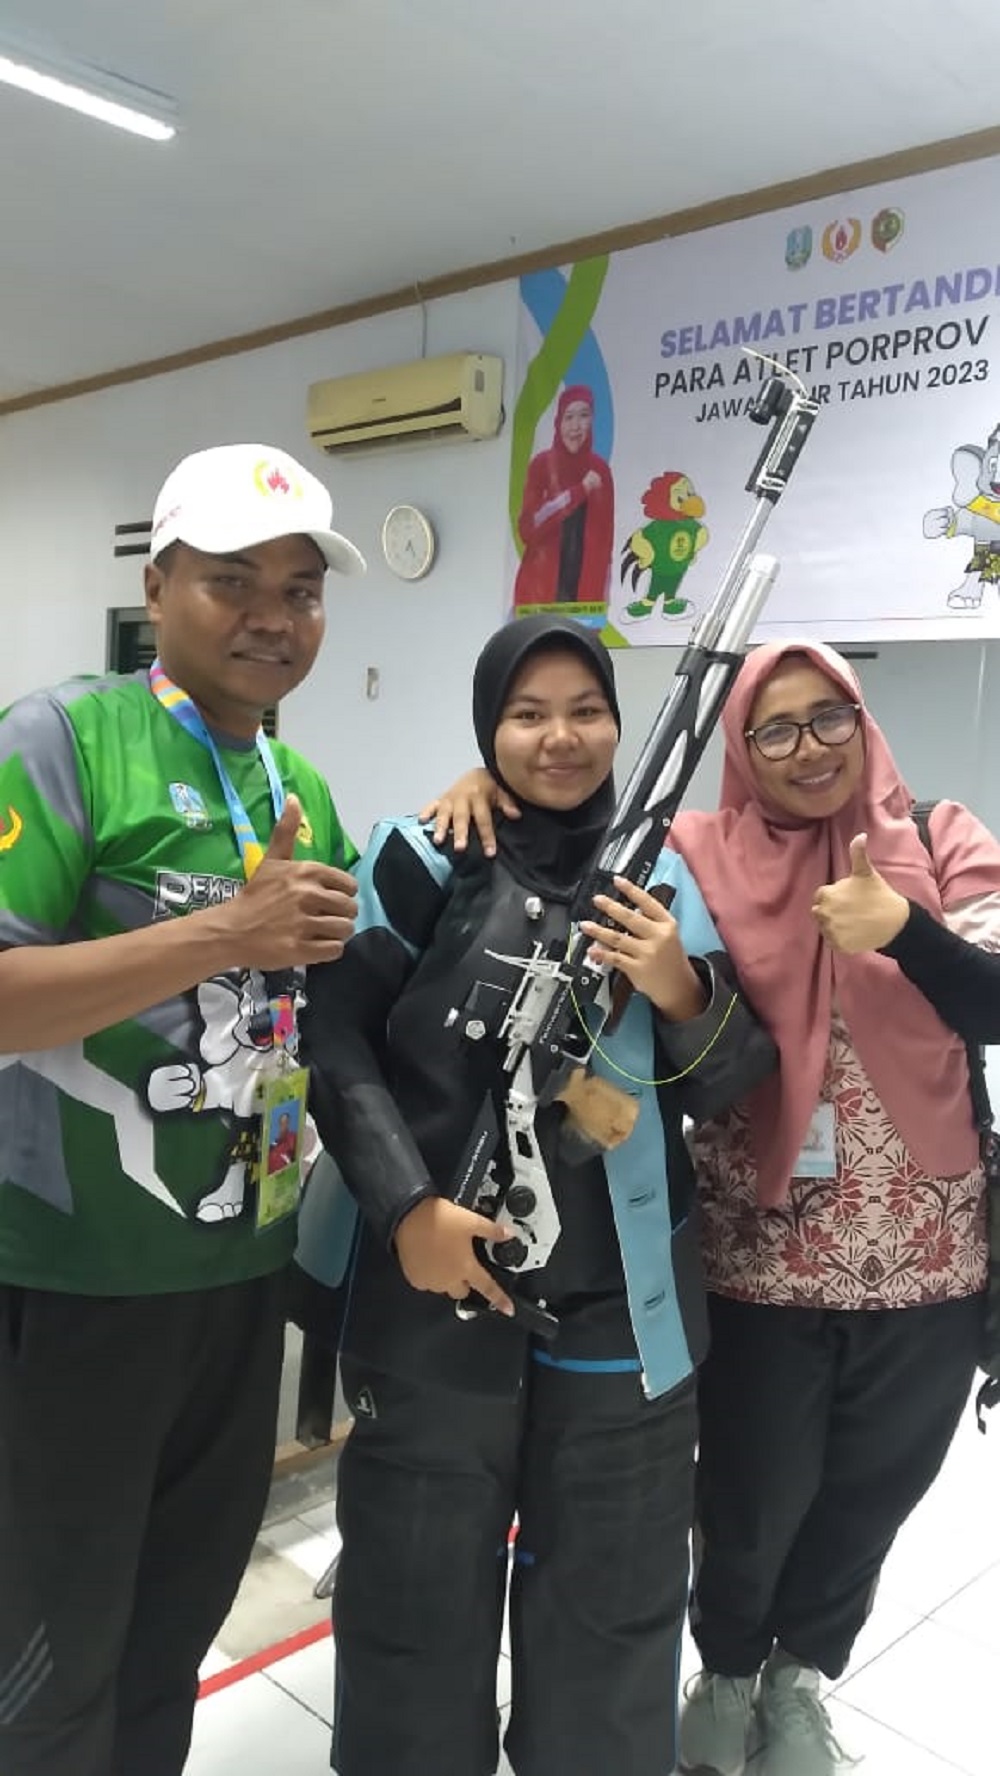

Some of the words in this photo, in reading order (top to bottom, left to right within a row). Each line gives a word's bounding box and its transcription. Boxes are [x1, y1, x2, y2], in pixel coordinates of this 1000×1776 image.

[654, 362, 726, 398] PARA
[732, 345, 819, 386] ATLET
[825, 314, 990, 370] PORPROV
[660, 302, 807, 358] SELAMAT
[838, 369, 920, 402] TAHUN
[926, 358, 990, 388] 2023
